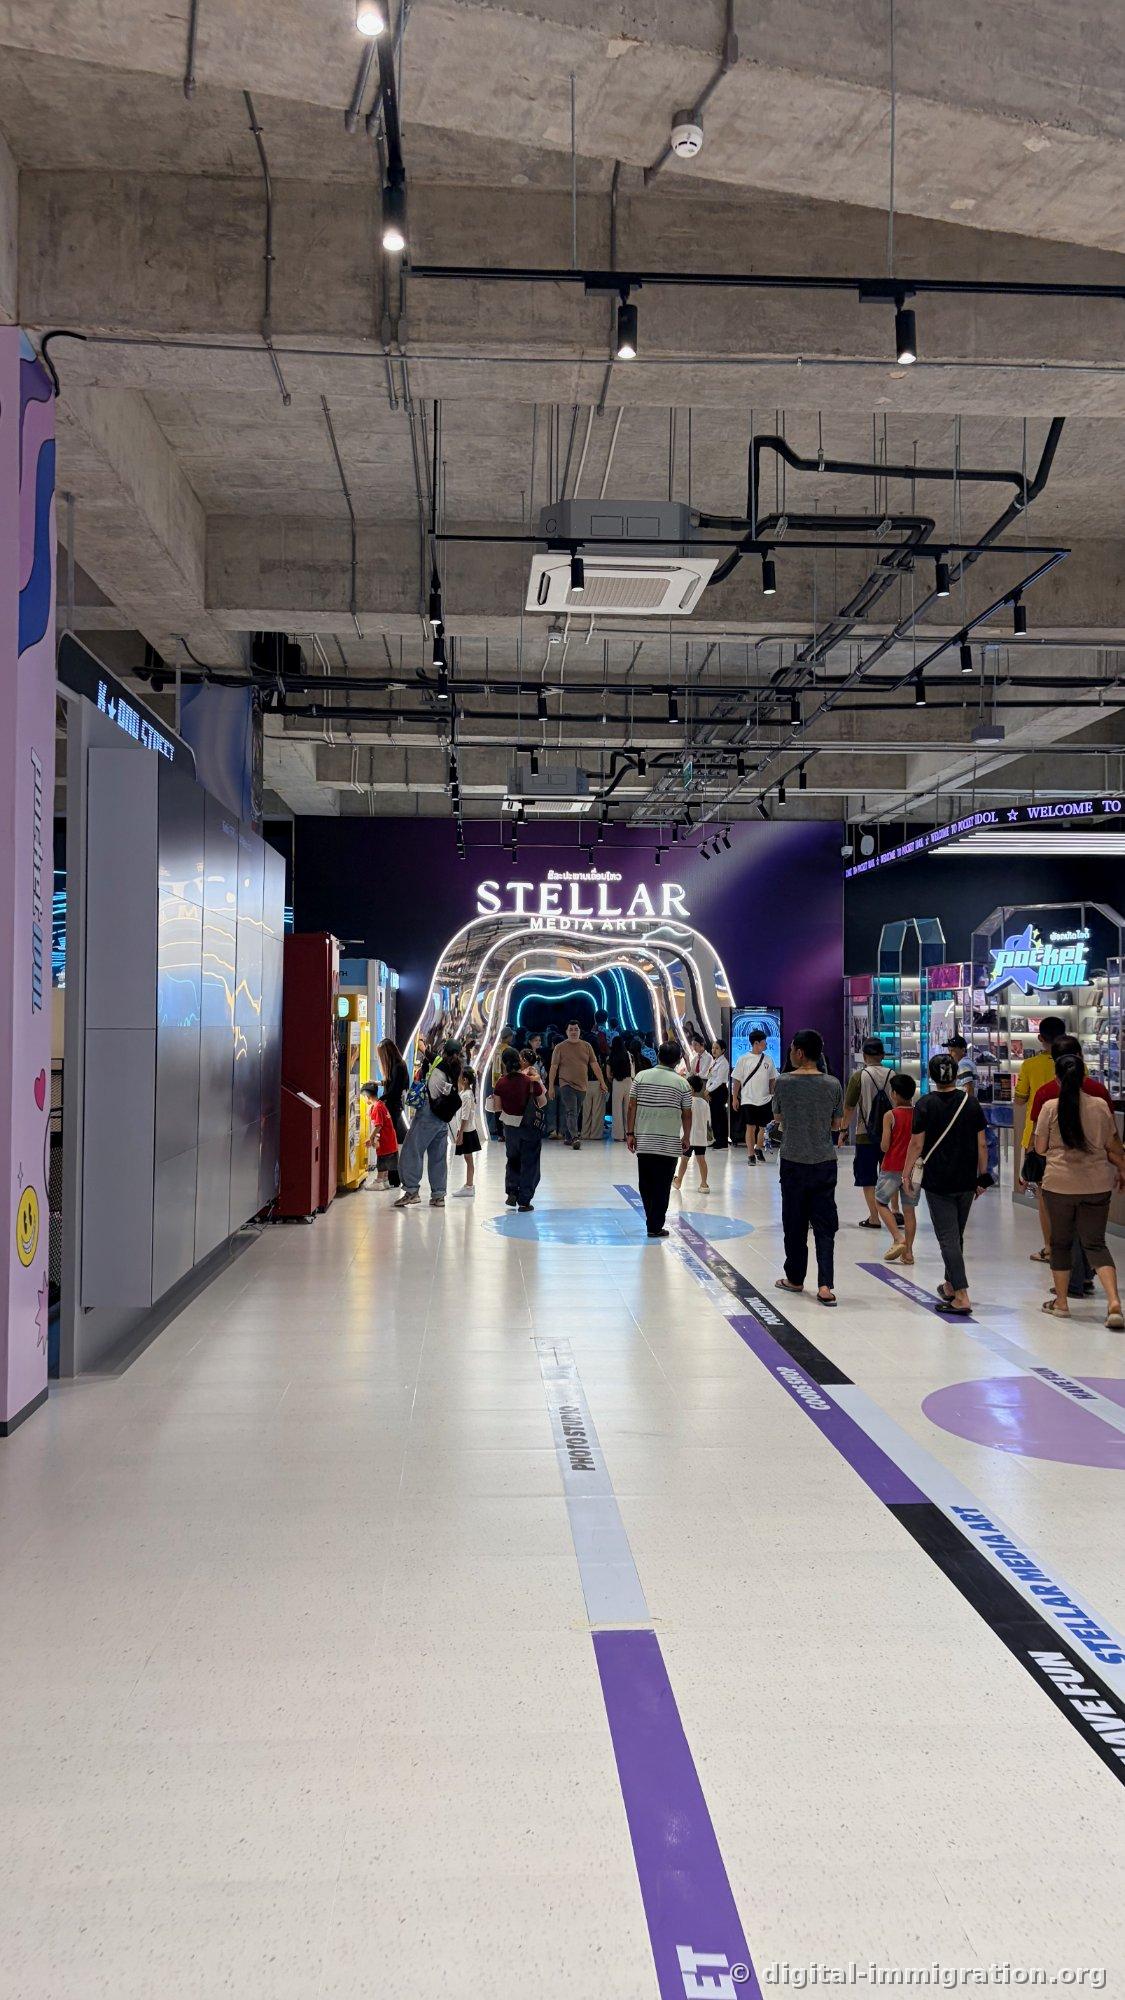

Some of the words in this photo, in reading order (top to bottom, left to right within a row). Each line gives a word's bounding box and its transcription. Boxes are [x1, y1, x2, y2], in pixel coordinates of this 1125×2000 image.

[974, 811, 998, 825] IDOL
[1027, 801, 1093, 819] WELCOME
[1102, 800, 1121, 812] TO
[476, 880, 691, 916] STELLAR
[530, 918, 593, 931] MEDIA
[602, 918, 638, 931] ART
[776, 1366, 808, 1385] SHOP
[1029, 1367, 1067, 1381] FUN
[792, 1384, 831, 1410] GOODS
[1051, 1381, 1099, 1400] HAVE
[559, 1405, 586, 1437] STUDIO
[566, 1437, 596, 1471] PHOTO
[950, 1506, 1001, 1532] ART
[980, 1535, 1052, 1583] MEDIA
[1029, 1585, 1125, 1665] STELLAR
[1027, 1650, 1101, 1697] FUN
[1069, 1699, 1125, 1765] AVE
